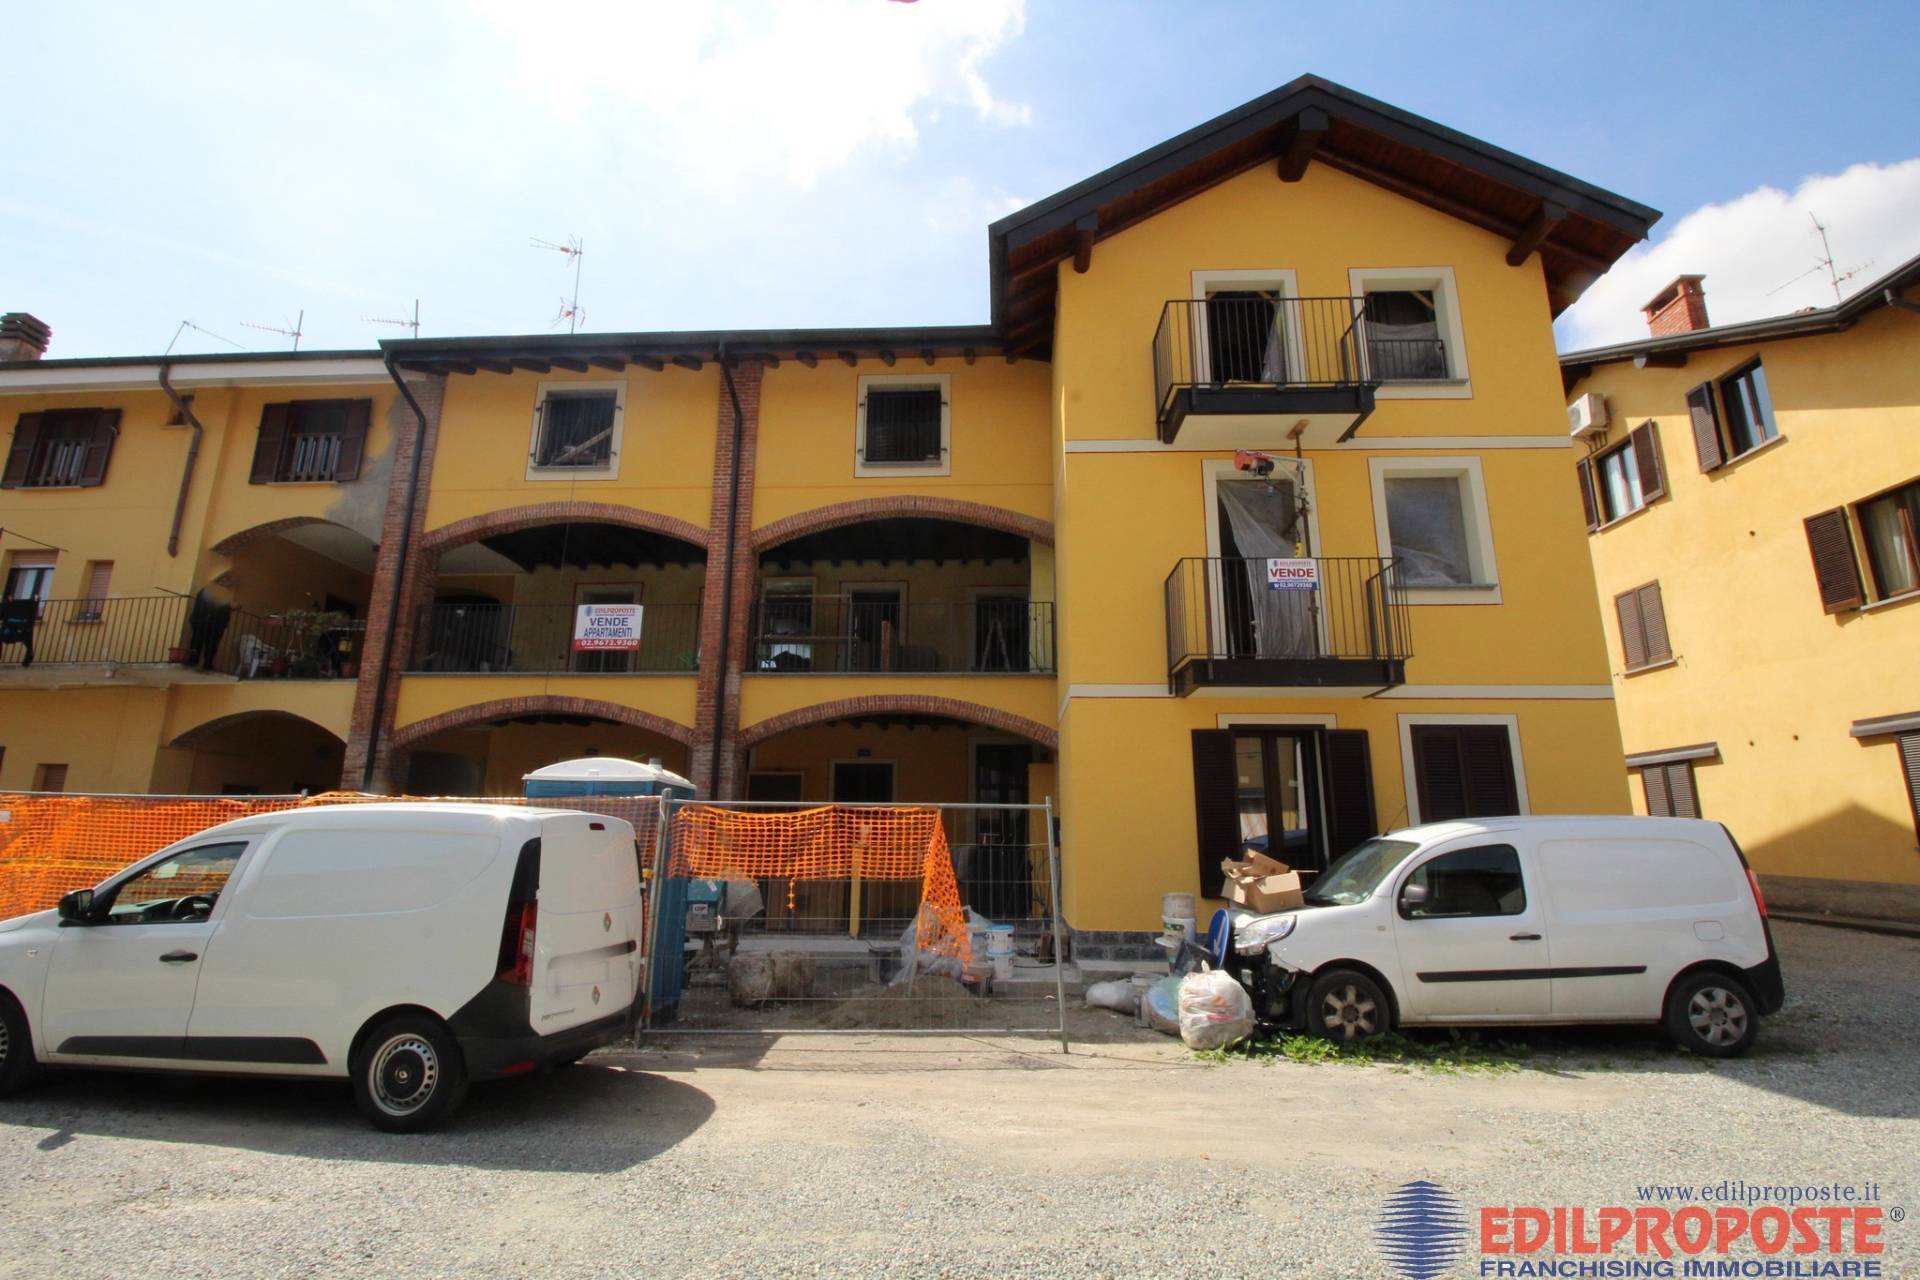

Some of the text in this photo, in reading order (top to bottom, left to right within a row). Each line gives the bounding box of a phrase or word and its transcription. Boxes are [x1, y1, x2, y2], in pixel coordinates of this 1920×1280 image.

[1270, 568, 1314, 577] VENDE
[590, 617, 629, 626] VENDE
[583, 627, 633, 638] APPARTAMENTI
